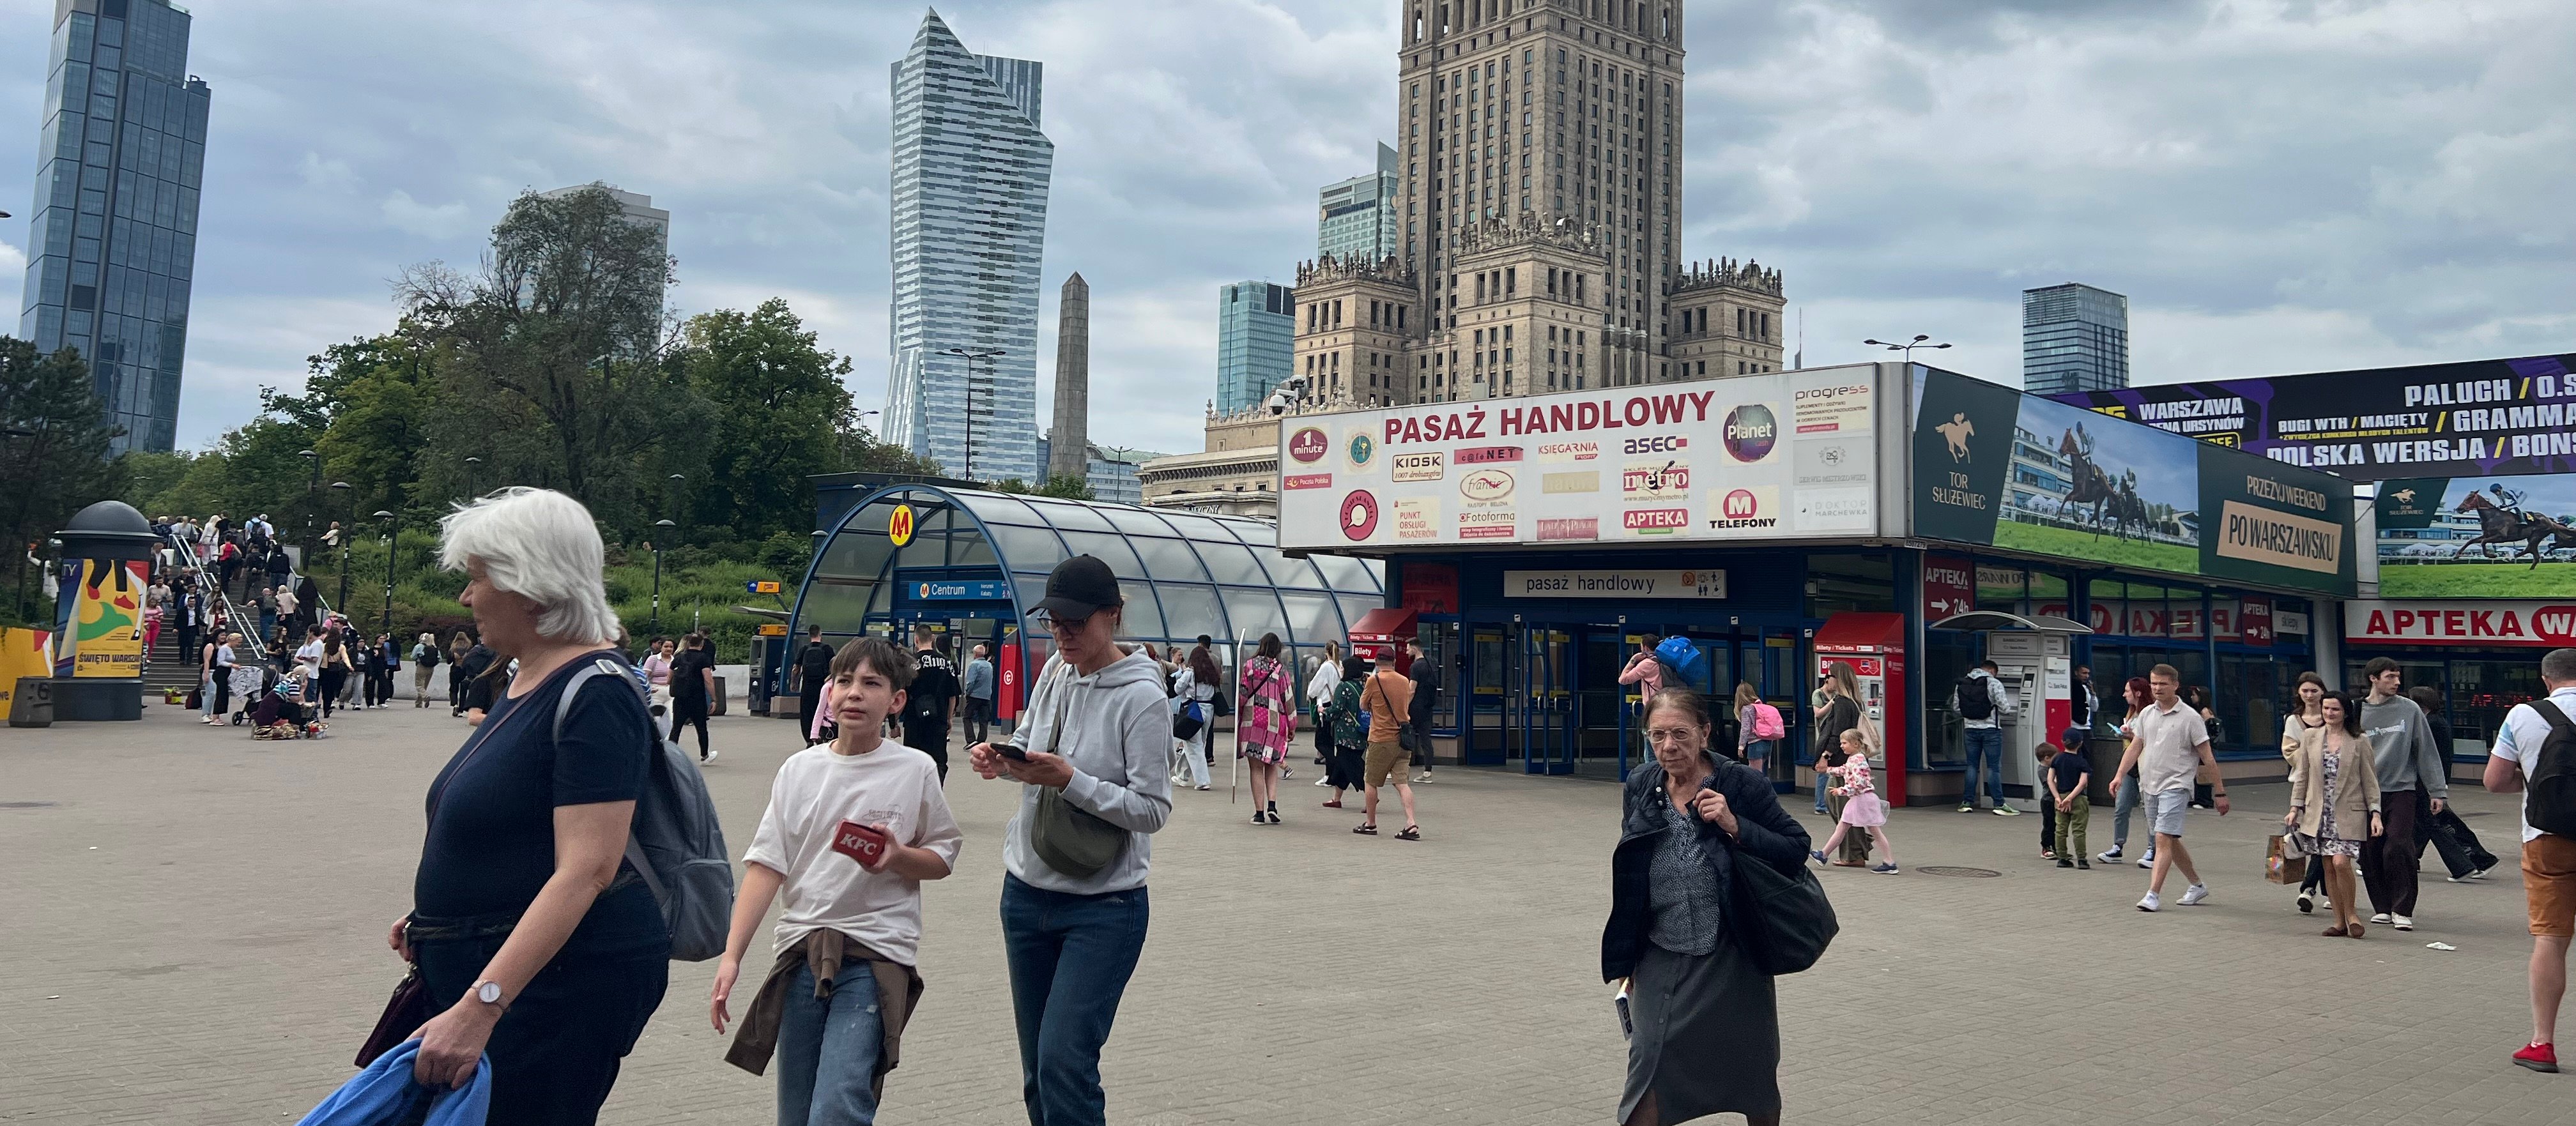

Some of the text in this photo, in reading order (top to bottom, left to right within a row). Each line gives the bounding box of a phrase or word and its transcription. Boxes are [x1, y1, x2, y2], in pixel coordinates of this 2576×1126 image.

[1795, 385, 1868, 401] progress
[2405, 379, 2511, 407] PALUCH
[2138, 397, 2244, 420] WARSZAWA
[1385, 391, 1715, 445] PASAŻ HANDLOWY
[2182, 417, 2244, 432] URSYNÓW
[2278, 419, 2312, 432] BUGI
[2315, 418, 2348, 430] WTH
[2361, 413, 2428, 427] MACIĘTY
[1303, 431, 1312, 446] 1
[1728, 422, 1772, 439] Planet
[1294, 444, 1323, 455] minute
[1538, 442, 1598, 455] KSIĘGARNIA
[1624, 436, 1676, 455] asec
[2372, 437, 2487, 463] WERSJA
[2511, 432, 2576, 457] BON
[1395, 456, 1441, 469] KIOSK
[1624, 471, 1687, 489] metro
[1949, 471, 1968, 489] TOR
[1729, 496, 1751, 515] M
[2285, 488, 2326, 511] WEEKEND
[1400, 521, 1426, 529] OBSŁUGI
[1466, 511, 1515, 522] Fotoforma
[1627, 511, 1685, 526] APTEKA
[1710, 519, 1776, 529] TELEFONY
[2229, 514, 2334, 562] PO WARSZAWSKU
[1527, 575, 1655, 594] pasaż handlowy
[1926, 567, 1968, 586] APTEKA
[931, 584, 965, 595] Centrum
[2244, 602, 2268, 616] APTEKA
[2366, 610, 2524, 637] APTEKA
[79, 652, 110, 664] ŚWIĘTO
[839, 833, 877, 855] KFC
